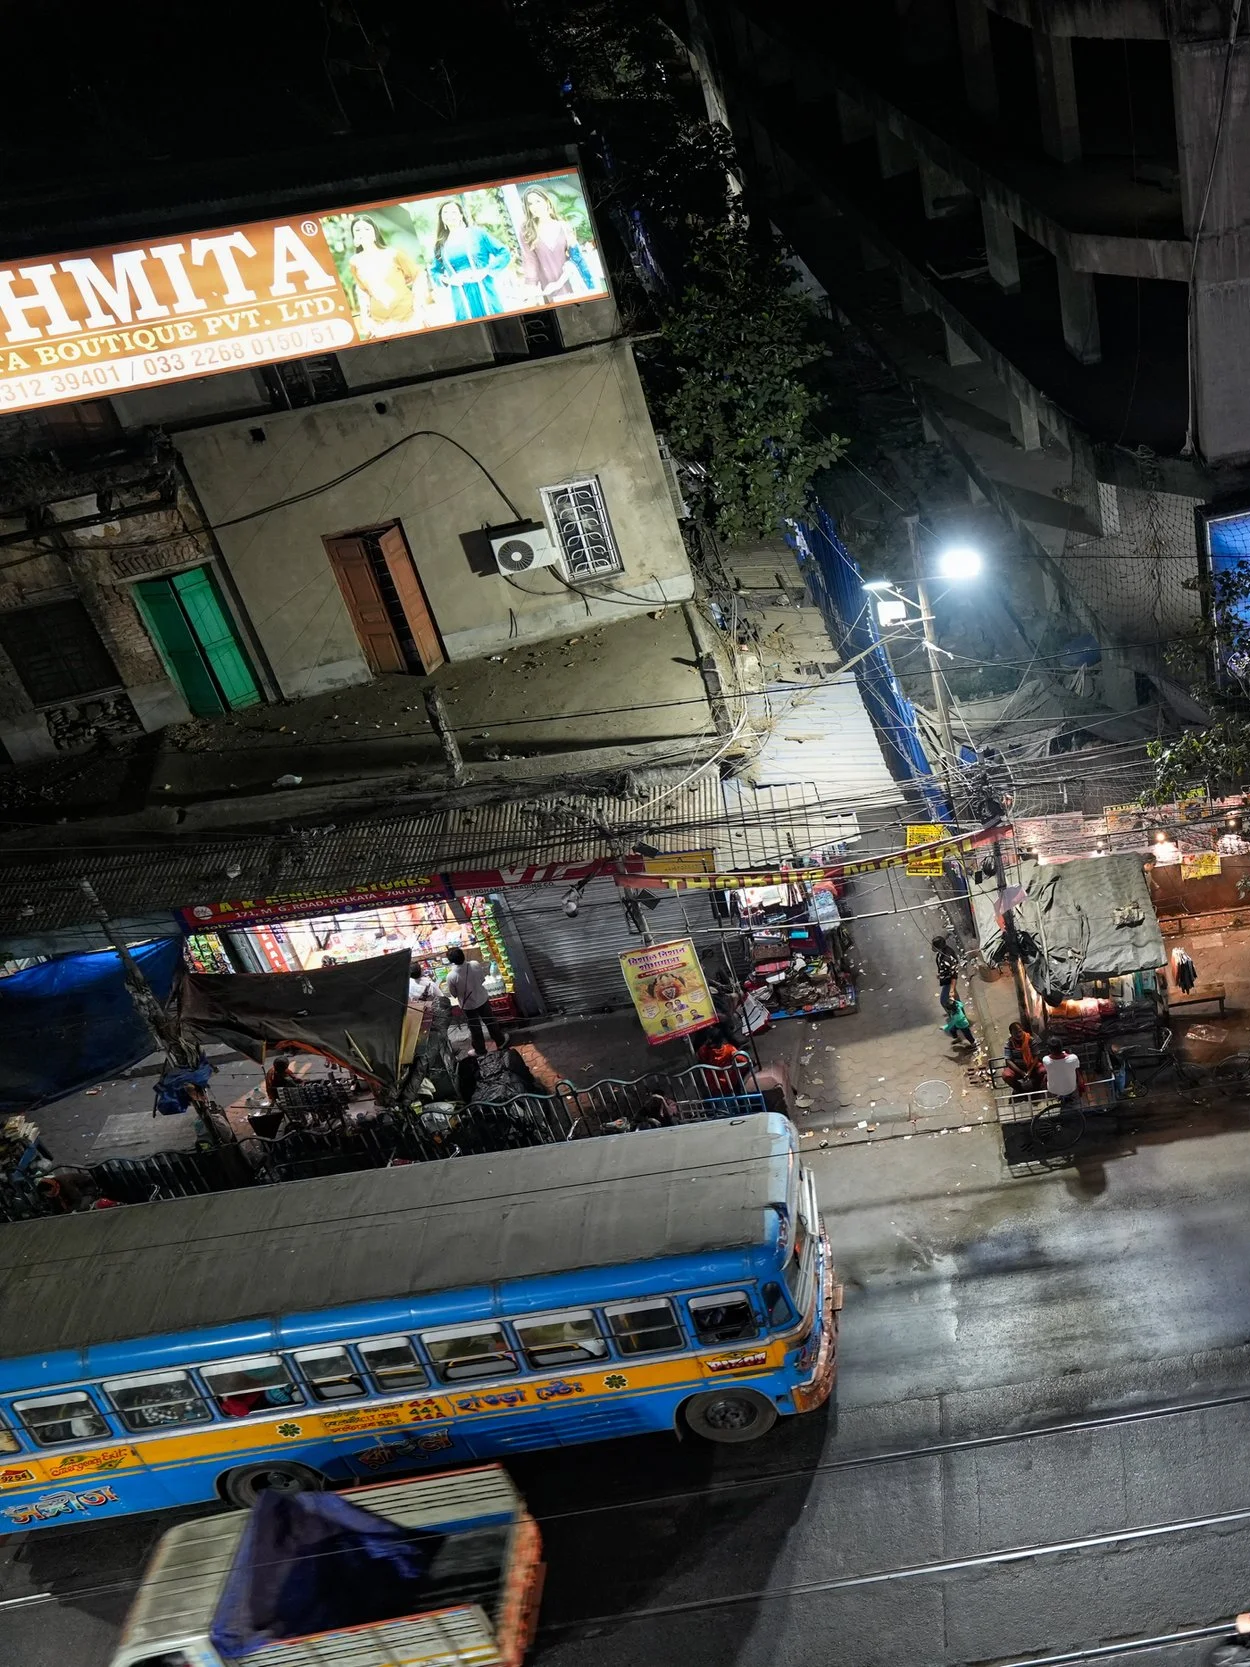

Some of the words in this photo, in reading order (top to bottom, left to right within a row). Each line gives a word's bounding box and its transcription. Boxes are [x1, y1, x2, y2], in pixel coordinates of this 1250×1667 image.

[34, 322, 197, 366] BOUTIQUE
[203, 308, 271, 336] PVT.
[280, 296, 345, 323] LTD.
[0, 379, 45, 403] 312
[55, 364, 121, 391] 39401
[144, 354, 185, 377] 033
[191, 343, 245, 367] 2268
[251, 324, 337, 356] 0150/51
[292, 900, 327, 911] ROAD,
[330, 892, 377, 904] KOLKATA
[408, 1399, 435, 1408] 44
[409, 1405, 442, 1416] 441
[456, 1389, 527, 1412] হাওড়া
